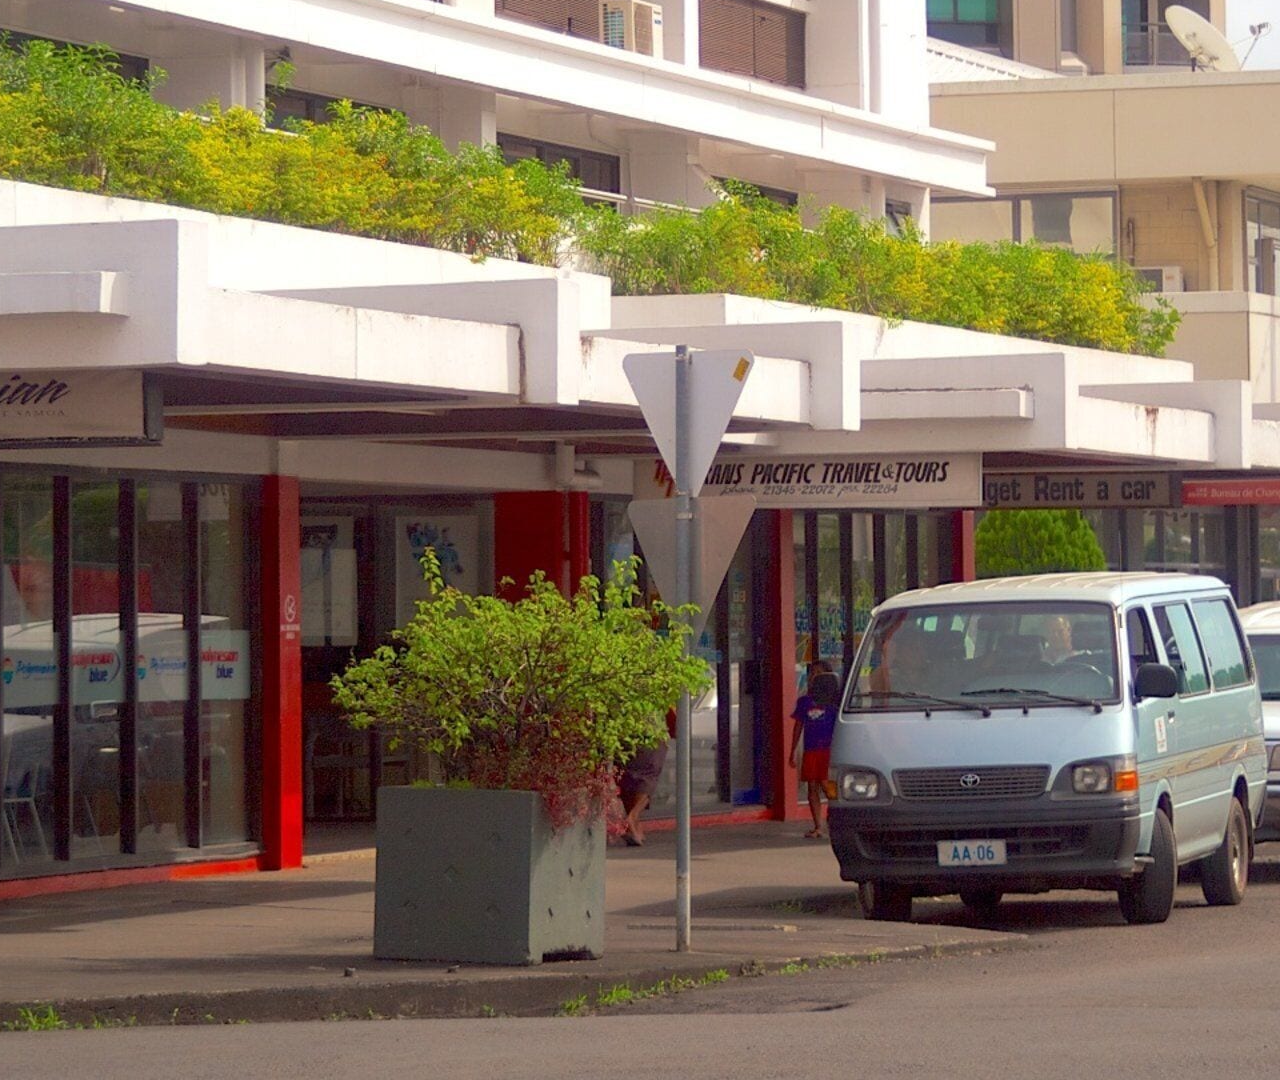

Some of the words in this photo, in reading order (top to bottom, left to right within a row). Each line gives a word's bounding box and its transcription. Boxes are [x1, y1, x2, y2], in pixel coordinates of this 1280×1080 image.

[751, 463, 814, 485] PACIFIC
[823, 462, 882, 484] TRAVEL
[895, 461, 951, 483] TOURS
[986, 475, 1021, 506] get
[1034, 475, 1084, 502] Rent
[1097, 480, 1109, 501] a
[1121, 477, 1156, 500] car
[1210, 487, 1240, 499] Bureau
[1242, 487, 1253, 498] de
[89, 668, 109, 683] blue
[216, 663, 234, 680] blue
[952, 845, 972, 861] AA
[977, 844, 995, 861] 06
